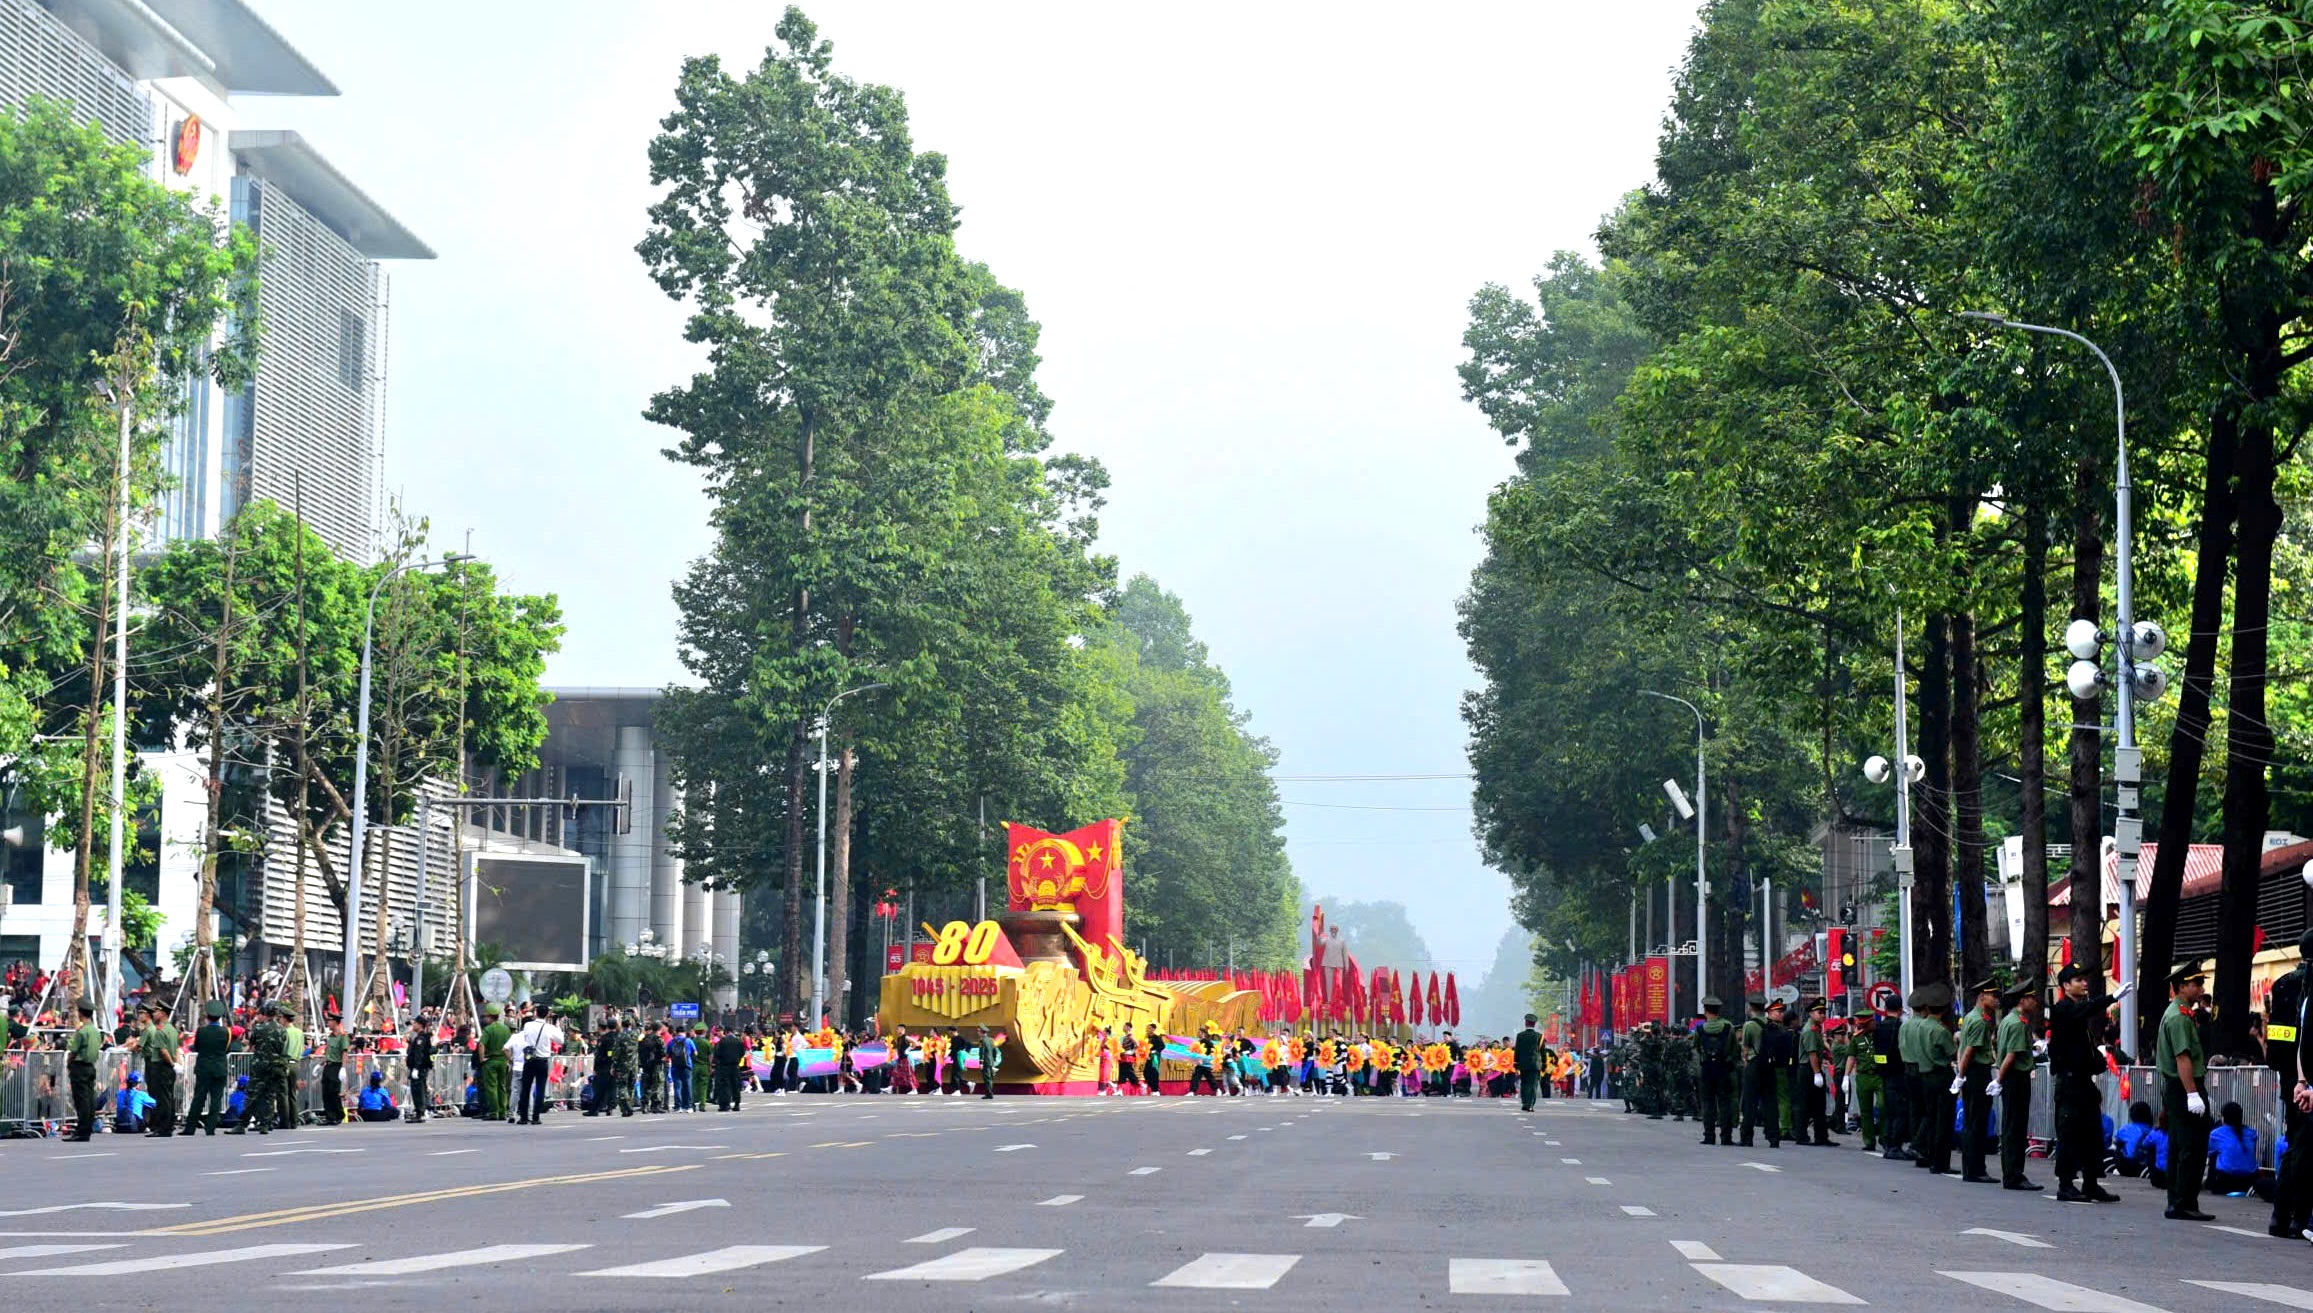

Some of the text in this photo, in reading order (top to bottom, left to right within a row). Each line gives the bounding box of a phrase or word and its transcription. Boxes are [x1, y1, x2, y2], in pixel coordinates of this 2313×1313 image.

[933, 920, 1001, 965] 80
[912, 977, 944, 995] 1945
[960, 977, 997, 995] 2025
